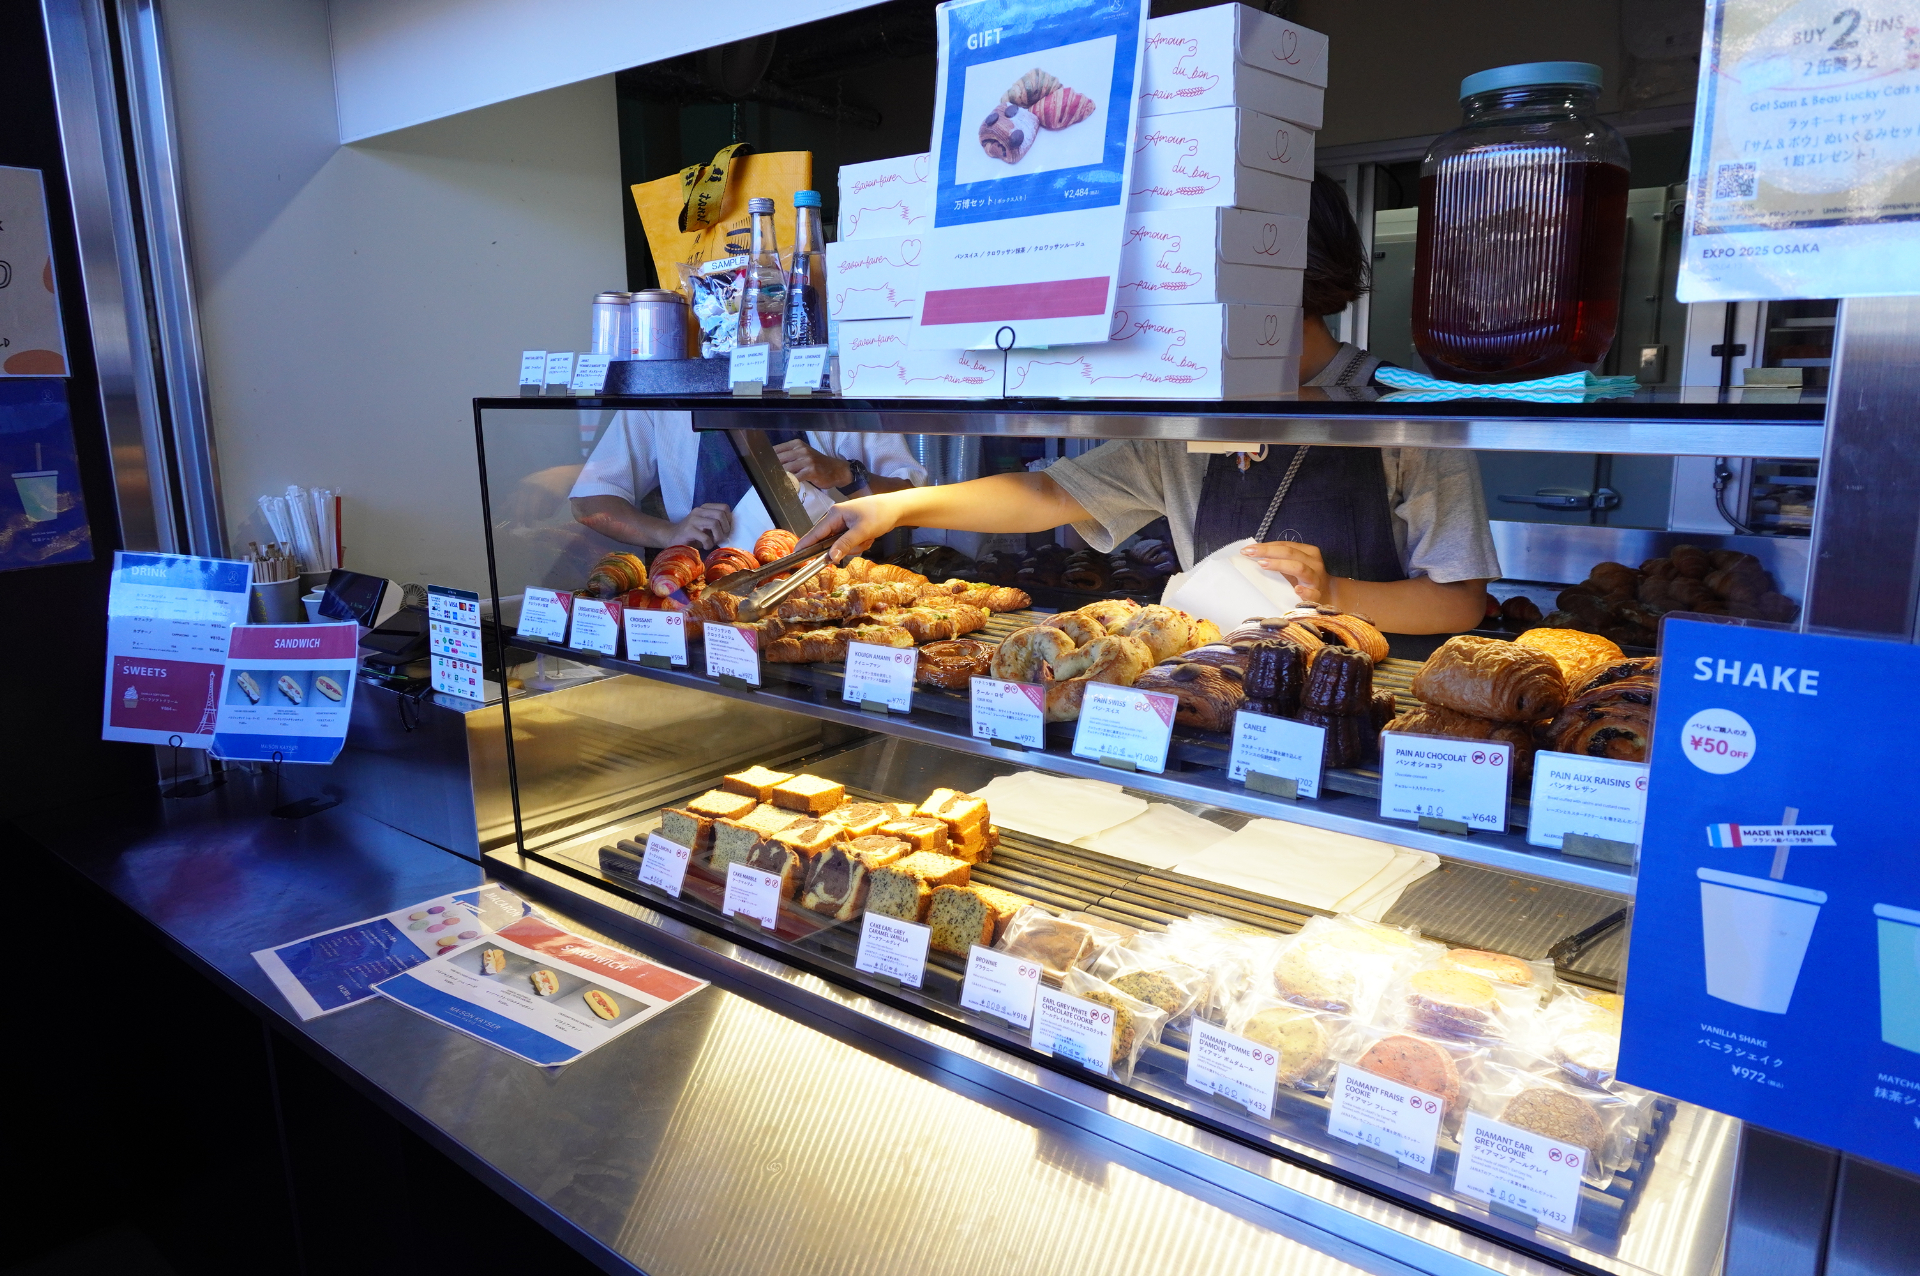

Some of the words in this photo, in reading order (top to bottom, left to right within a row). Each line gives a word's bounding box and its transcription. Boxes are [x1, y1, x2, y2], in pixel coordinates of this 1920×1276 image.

[1794, 27, 1826, 45] BUY
[1828, 8, 1862, 51] 2
[1866, 15, 1904, 34] TINS
[967, 28, 1003, 50] GIFT
[1750, 101, 1770, 112] Get
[1773, 100, 1797, 110] Sam
[1801, 98, 1808, 106] &
[1812, 93, 1842, 105] Beau
[1845, 89, 1879, 102] Lucky
[1884, 85, 1910, 97] Cats
[1788, 109, 1886, 131] ラッキーキャッツ
[1064, 188, 1088, 198] ¥2,484
[954, 196, 992, 210] 万博セット
[1702, 248, 1735, 258] EXPO
[1739, 246, 1769, 256] 2025
[1773, 243, 1820, 254] OSAKA
[712, 256, 746, 270] SAMPLE
[132, 566, 166, 578] DRINK
[274, 638, 320, 648] SANDWICH
[123, 666, 167, 678] SWEETS
[1694, 656, 1820, 696] SHAKE
[1108, 699, 1126, 708] SWISS
[1244, 722, 1266, 732] CANELÉ
[1692, 722, 1748, 738] パンもご購入の方
[1690, 734, 1728, 755] ¥50
[1730, 750, 1748, 759] OFF
[1136, 752, 1158, 763] ¥1,080
[1396, 749, 1412, 757] PAIN
[1426, 752, 1467, 762] CHOCOLAT
[1396, 760, 1442, 770] パンオショコラ
[1550, 770, 1571, 780] PAIN
[1573, 774, 1592, 784] AUX
[1594, 776, 1631, 788] RAISINS
[1550, 782, 1598, 793] パンオレザン
[1472, 813, 1497, 824] ¥648
[561, 944, 630, 972] SANDWICH
[976, 956, 998, 968] BROWNIE
[1042, 996, 1055, 1006] EARL
[1056, 1002, 1070, 1010] GREY
[1071, 1006, 1088, 1017] WHITE
[1042, 1003, 1072, 1018] CHOCOLATE
[1074, 1014, 1094, 1025] COOKIE
[1012, 1011, 1028, 1022] ¥918
[1700, 1023, 1737, 1040] VANILLA
[1738, 1033, 1768, 1048] SHAKE
[1200, 1032, 1228, 1047] DIAMANT
[1228, 1043, 1250, 1056] POMME
[1200, 1038, 1226, 1054] D'AMOUR
[1698, 1038, 1784, 1068] バニラシェイク
[1088, 1056, 1104, 1068] ¥432
[1732, 1064, 1766, 1084] ¥972
[1878, 1072, 1920, 1091] MATCHA
[1346, 1076, 1380, 1094] DIAMANT
[1380, 1090, 1405, 1104] FRAISE
[1346, 1084, 1372, 1098] COOKIE
[1874, 1086, 1920, 1108] 抹茶シ
[1248, 1098, 1266, 1112] ¥432
[1344, 1092, 1372, 1106] ディアマン
[1474, 1136, 1495, 1148] GREY
[1496, 1143, 1526, 1160] COOKIE
[1476, 1128, 1514, 1146] DIAMANT
[1514, 1142, 1534, 1154] EARL
[1404, 1150, 1426, 1164] ¥432
[1474, 1144, 1506, 1160] ディアマン
[1508, 1156, 1548, 1176] アールグレイ
[1542, 1208, 1567, 1224] ¥432
